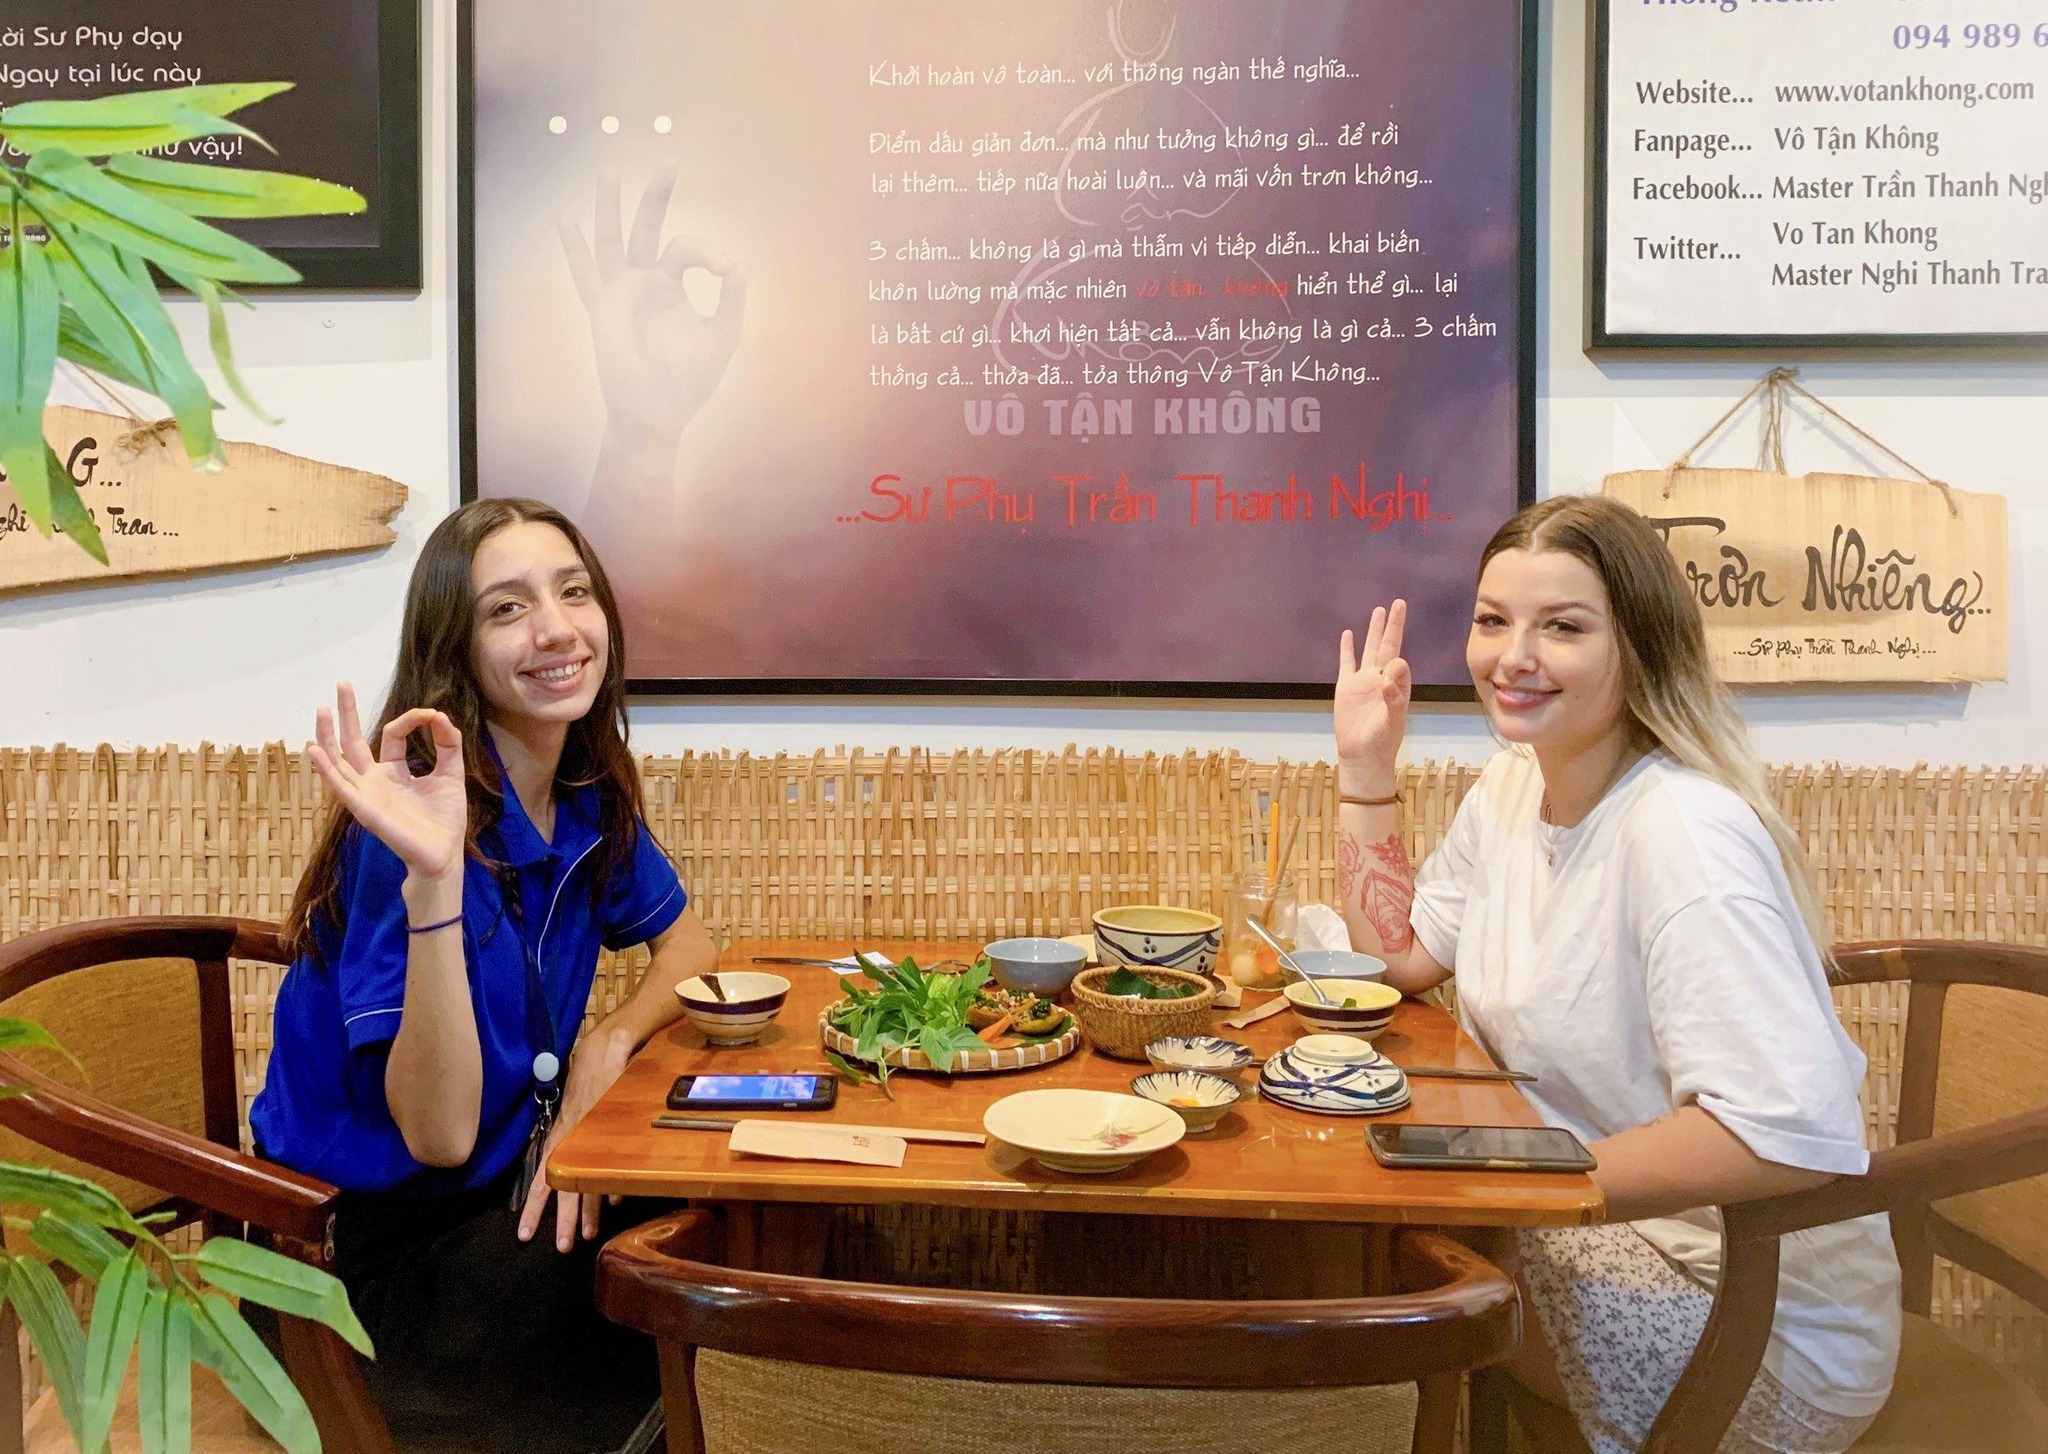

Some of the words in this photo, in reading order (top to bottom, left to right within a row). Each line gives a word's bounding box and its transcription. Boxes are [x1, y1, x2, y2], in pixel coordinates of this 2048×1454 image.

[0, 26, 24, 47] ời
[33, 26, 67, 47] Sư
[75, 26, 123, 51] Phụ
[132, 25, 183, 51] dạy
[1892, 23, 1951, 50] 094
[1963, 23, 2021, 49] 989
[68, 63, 101, 87] tại
[111, 62, 144, 82] lúc
[153, 61, 201, 86] này
[869, 59, 920, 86] Khởi
[928, 64, 974, 86] hoàn
[983, 65, 1007, 85] vô
[1015, 62, 1076, 84] toàn...
[1084, 62, 1113, 83] với
[1121, 60, 1184, 86] thông
[1192, 62, 1240, 85] ngàn
[1249, 55, 1285, 80] thế
[1294, 56, 1360, 83] nghĩa...
[1635, 79, 1754, 105] Website...
[1774, 76, 2035, 108] www.votankhong.com
[188, 135, 242, 161] vậy!
[869, 130, 921, 154] Điểm
[928, 129, 963, 153] dấu
[971, 132, 1011, 158] giản
[1019, 130, 1069, 152] đơn...
[1077, 132, 1106, 151] mà
[1114, 128, 1150, 151] như
[1156, 127, 1216, 153] tưởng
[1225, 126, 1288, 152] không
[1297, 126, 1329, 152] gì...
[1337, 121, 1366, 146] để
[1371, 121, 1399, 145] rồi
[1633, 128, 1753, 159] Fanpage...
[1773, 127, 1806, 151] Vô
[1813, 126, 1857, 156] Tận
[1865, 124, 1939, 157] Không
[872, 172, 893, 198] lại
[901, 170, 968, 193] thêm...
[976, 168, 1016, 196] tiếp
[1025, 171, 1059, 191] nữa
[1067, 168, 1107, 191] hoài
[1116, 168, 1175, 190] luôn...
[1182, 168, 1206, 189] và
[1215, 167, 1248, 188] mãi
[1255, 163, 1292, 188] vốn
[1300, 164, 1346, 187] trơn
[1354, 162, 1433, 189] không...
[1633, 174, 1763, 201] Facebook...
[1772, 175, 1854, 199] Master
[1862, 169, 1916, 199] Trần
[1925, 171, 1999, 198] Thanh
[2009, 171, 2048, 204] Ng
[868, 240, 887, 261] 3
[895, 237, 961, 261] chấm...
[969, 237, 1032, 264] không
[1043, 238, 1060, 259] là
[1068, 239, 1086, 263] gì
[1094, 238, 1123, 258] mà
[1191, 236, 1207, 257] vi
[1216, 232, 1257, 260] tiếp
[1265, 230, 1320, 255] diễn...
[1329, 231, 1370, 254] khai
[1377, 228, 1420, 253] biến
[1633, 235, 1741, 260] Twitter...
[1773, 221, 1804, 246] Vo
[1811, 221, 1855, 246] Tan
[1864, 219, 1938, 252] Khong
[868, 279, 917, 301] khôn
[927, 279, 982, 304] lường
[990, 281, 1019, 300] mà
[1027, 279, 1068, 304] mặc
[1076, 277, 1127, 299] nhiên
[1297, 271, 1338, 296] hiển
[1346, 270, 1386, 295] thể
[1392, 273, 1424, 298] gì...
[1435, 272, 1458, 298] lại
[1771, 263, 1853, 287] Master
[1861, 260, 1918, 293] Nghi
[1926, 259, 2000, 286] Thanh
[871, 324, 889, 345] là
[897, 321, 932, 344] bất
[940, 324, 964, 344] cứ
[971, 323, 1002, 348] gì...
[1010, 321, 1051, 344] khơi
[1059, 321, 1098, 348] hiện
[1106, 318, 1142, 343] tất
[1149, 321, 1188, 342] cả...
[1195, 317, 1231, 341] vẫn
[1239, 318, 1303, 344] không
[1313, 318, 1332, 339] là
[1340, 318, 1359, 343] gì
[1366, 317, 1405, 338] cả...
[1413, 316, 1434, 338] 3
[1442, 313, 1497, 338] chấm
[869, 363, 928, 390] thống
[936, 366, 974, 386] cả...
[982, 363, 1029, 385] thỏa
[1037, 363, 1074, 385] đã...
[1082, 362, 1118, 385] tỏa
[1126, 362, 1189, 388] thông
[1197, 357, 1233, 383] Vô
[1241, 361, 1283, 387] Tận
[1291, 355, 1380, 385] Không...
[963, 392, 1025, 437] VÔ
[1043, 392, 1133, 444] TẬN
[1154, 389, 1322, 436] KHÔNG
[946, 475, 1035, 534] Phụ
[1173, 473, 1314, 528] Thanh
[1841, 638, 1883, 656] Thanh
